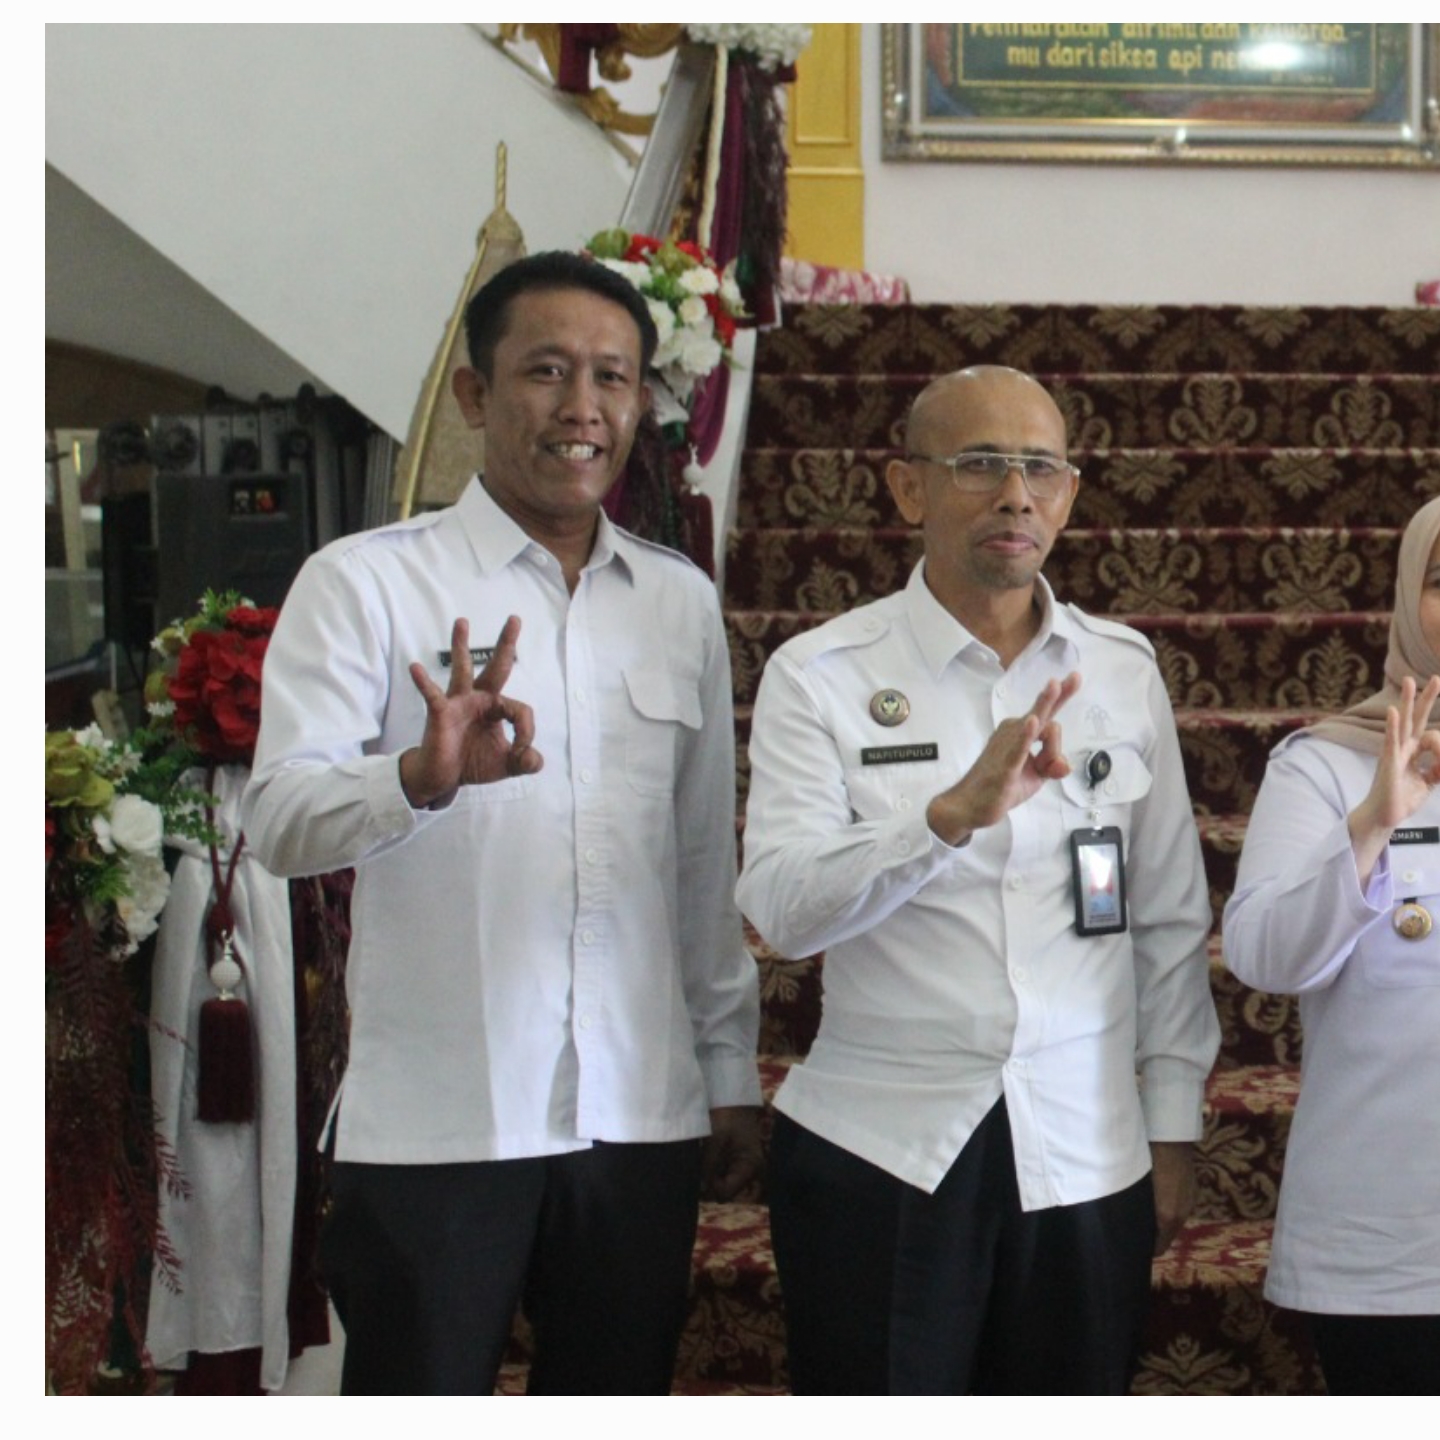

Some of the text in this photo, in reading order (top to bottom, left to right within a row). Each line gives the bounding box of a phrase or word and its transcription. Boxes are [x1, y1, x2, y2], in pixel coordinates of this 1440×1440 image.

[1007, 46, 1040, 67] mu
[1046, 40, 1095, 68] dari
[1099, 39, 1157, 68] siksa
[1168, 43, 1203, 76] api
